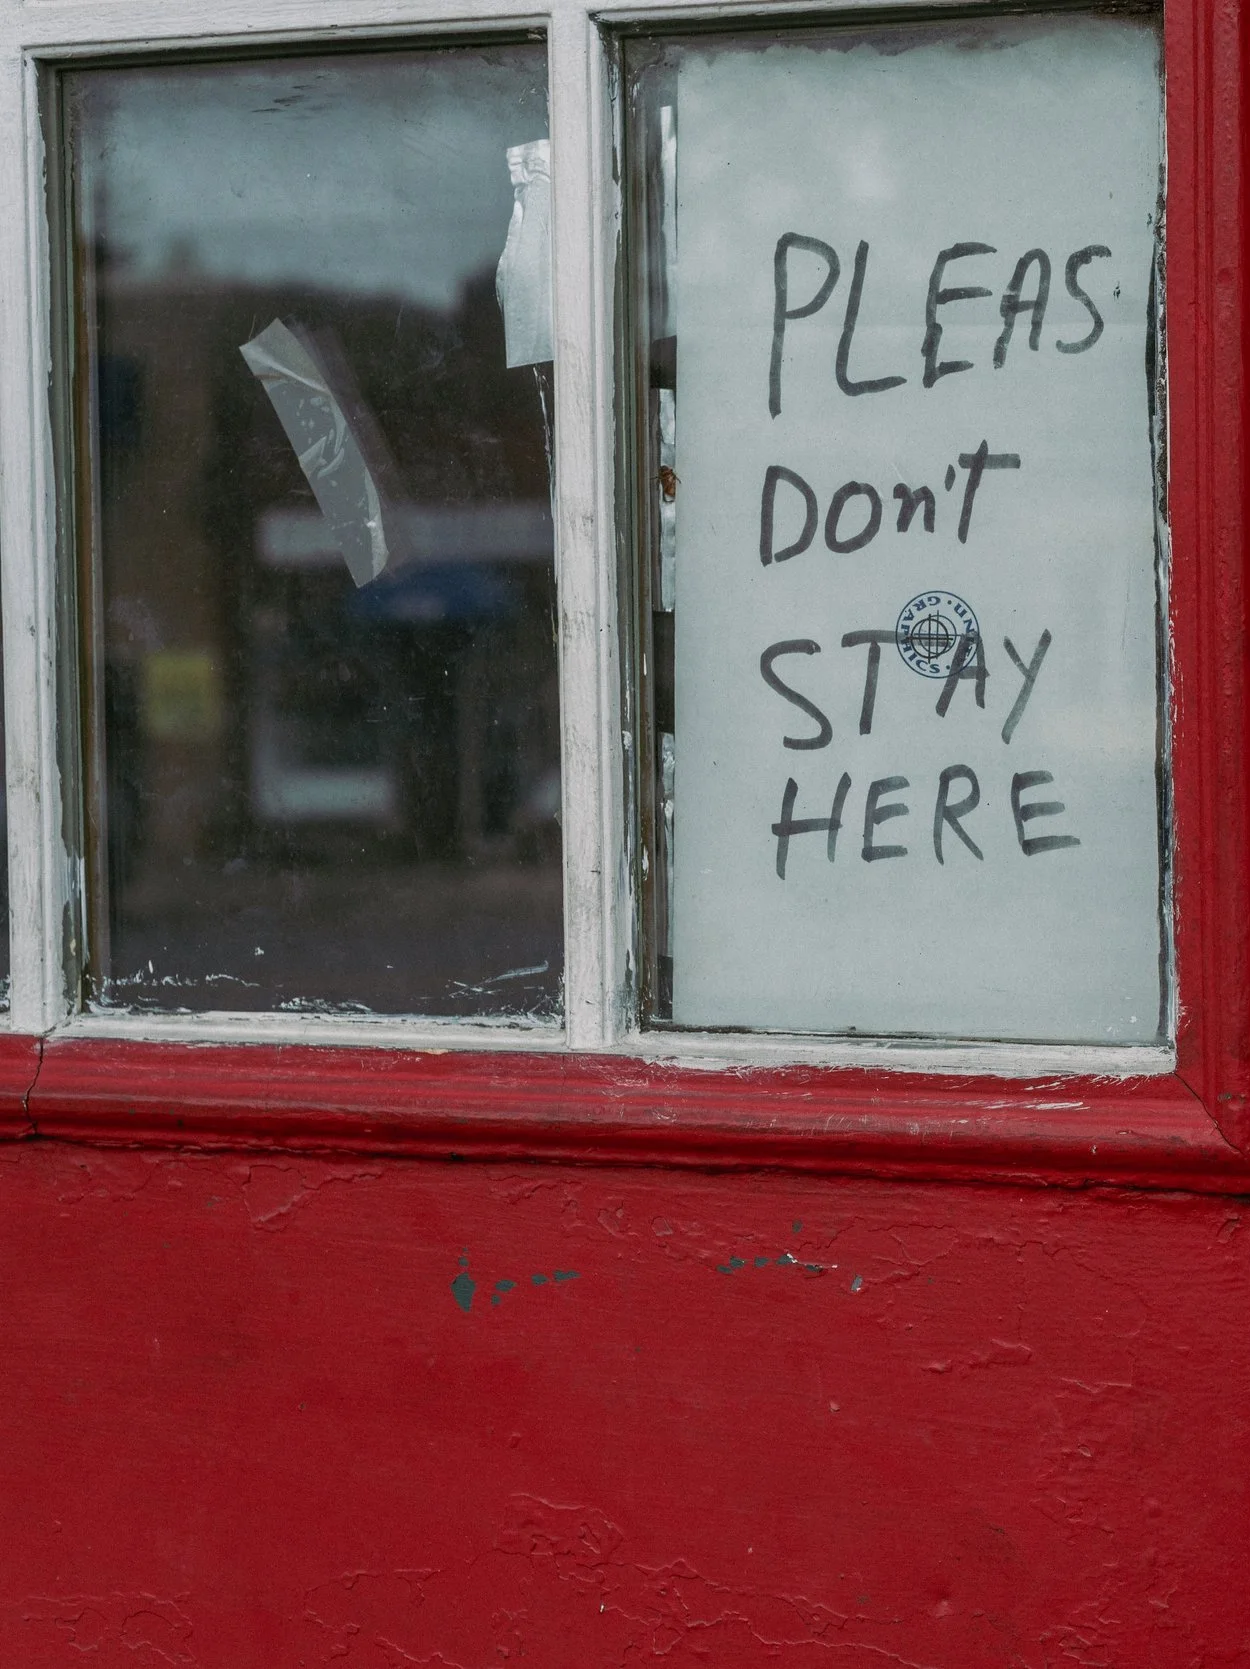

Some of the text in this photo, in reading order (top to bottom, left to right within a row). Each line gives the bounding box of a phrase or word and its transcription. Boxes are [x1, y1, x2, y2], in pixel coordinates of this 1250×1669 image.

[768, 232, 1112, 418] PLEAS
[760, 628, 1052, 750] STAY
[900, 595, 975, 674] UNIT GRAPHICS
[771, 764, 1081, 880] HERE
